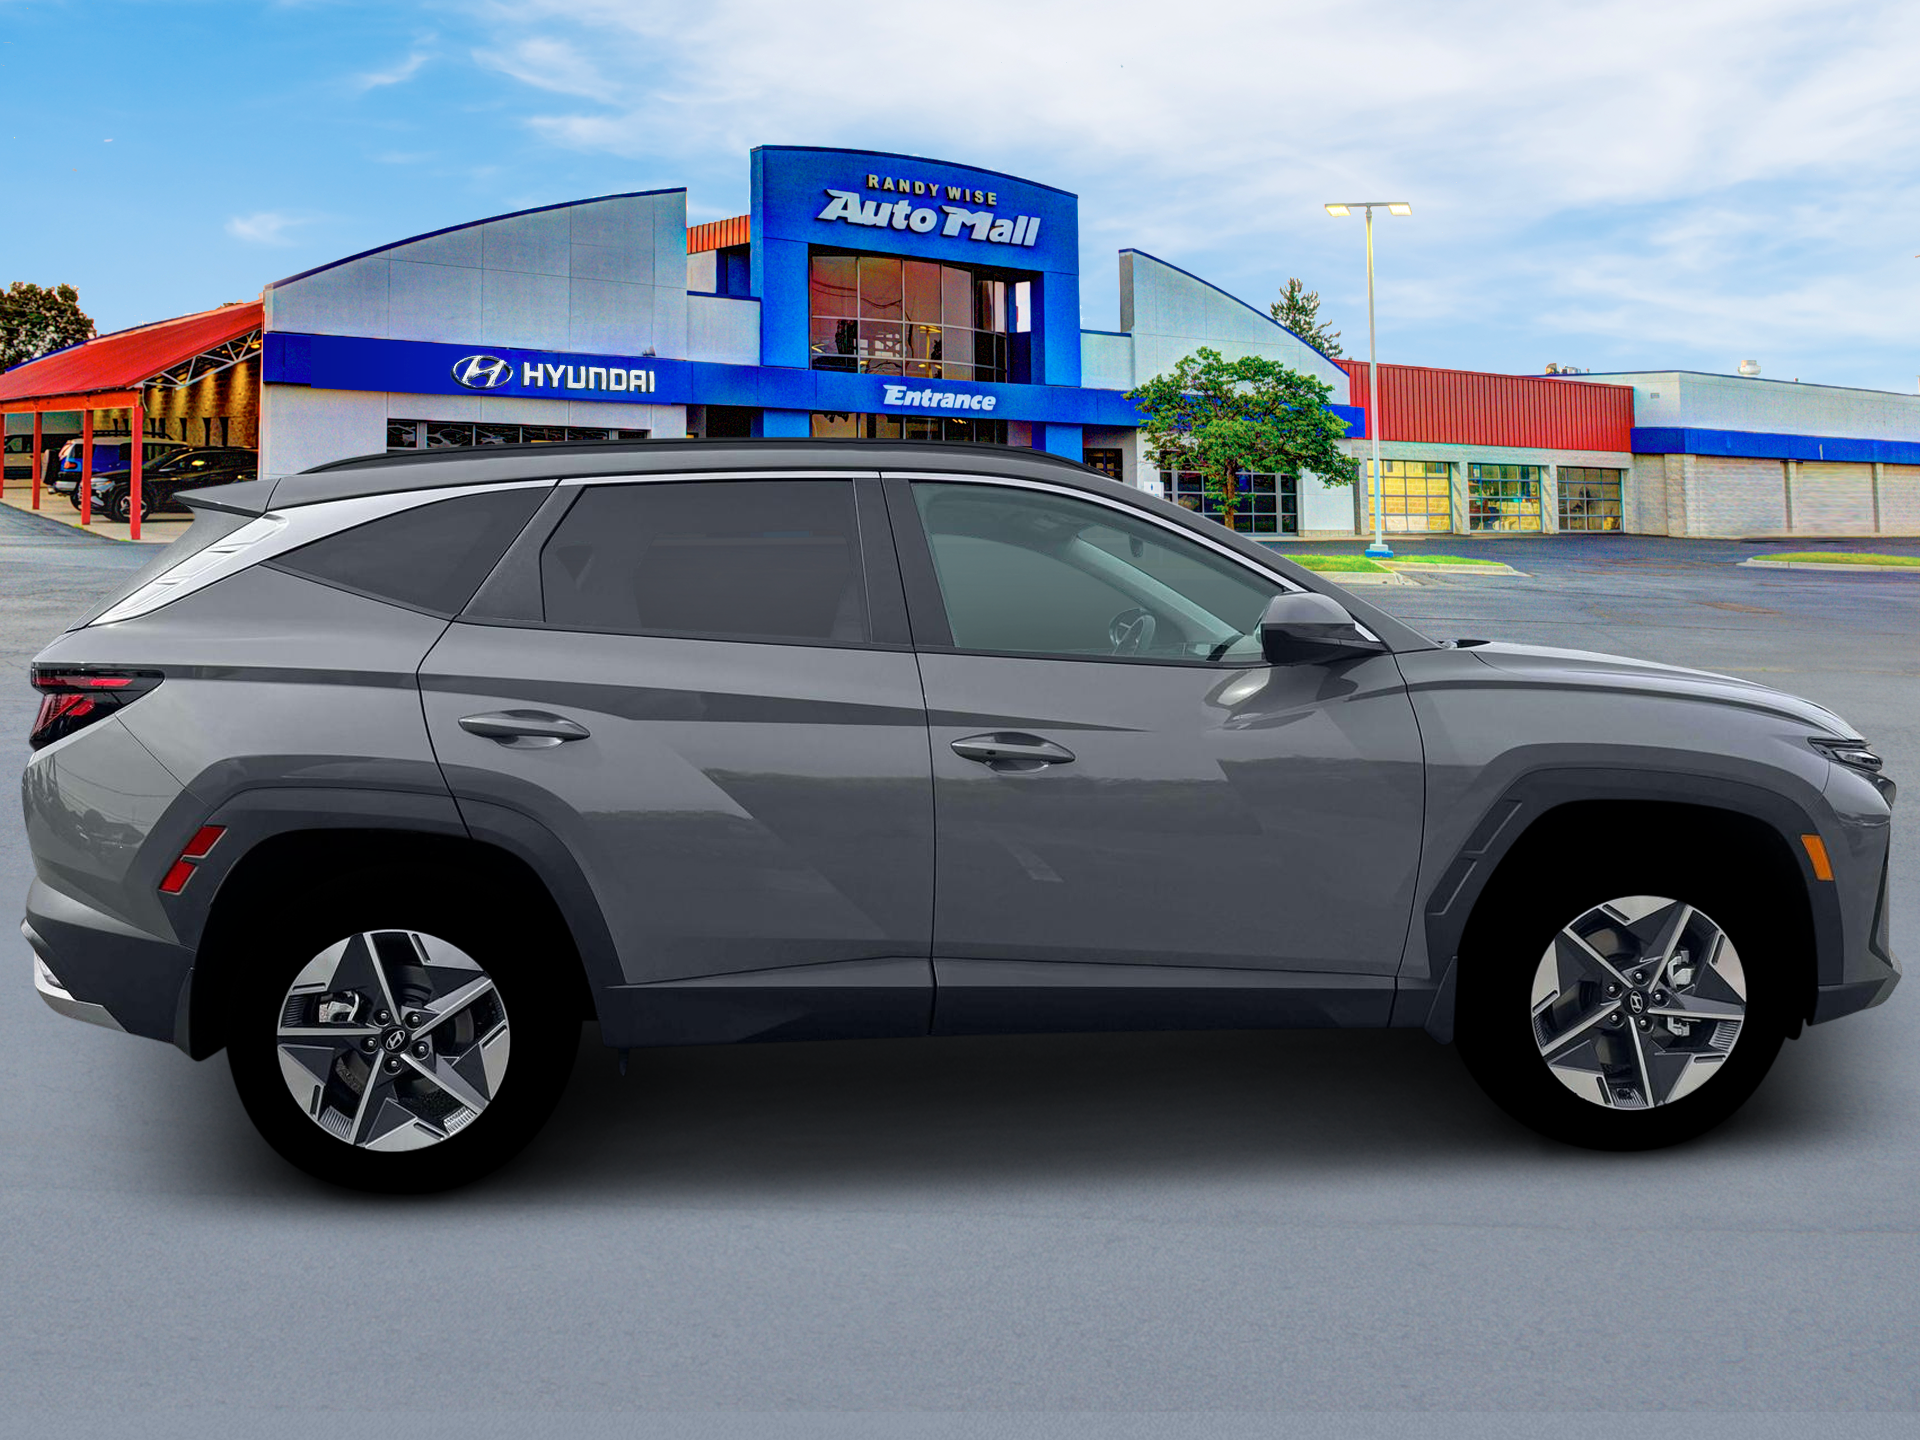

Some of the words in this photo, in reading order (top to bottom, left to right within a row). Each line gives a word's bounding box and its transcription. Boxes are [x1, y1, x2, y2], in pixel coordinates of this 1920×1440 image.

[866, 174, 939, 197] RANDY
[946, 185, 998, 206] WISE
[816, 188, 937, 233] Auto
[941, 205, 1041, 247] Mall
[521, 361, 656, 393] HYUNDAI
[883, 384, 996, 411] Entrance
